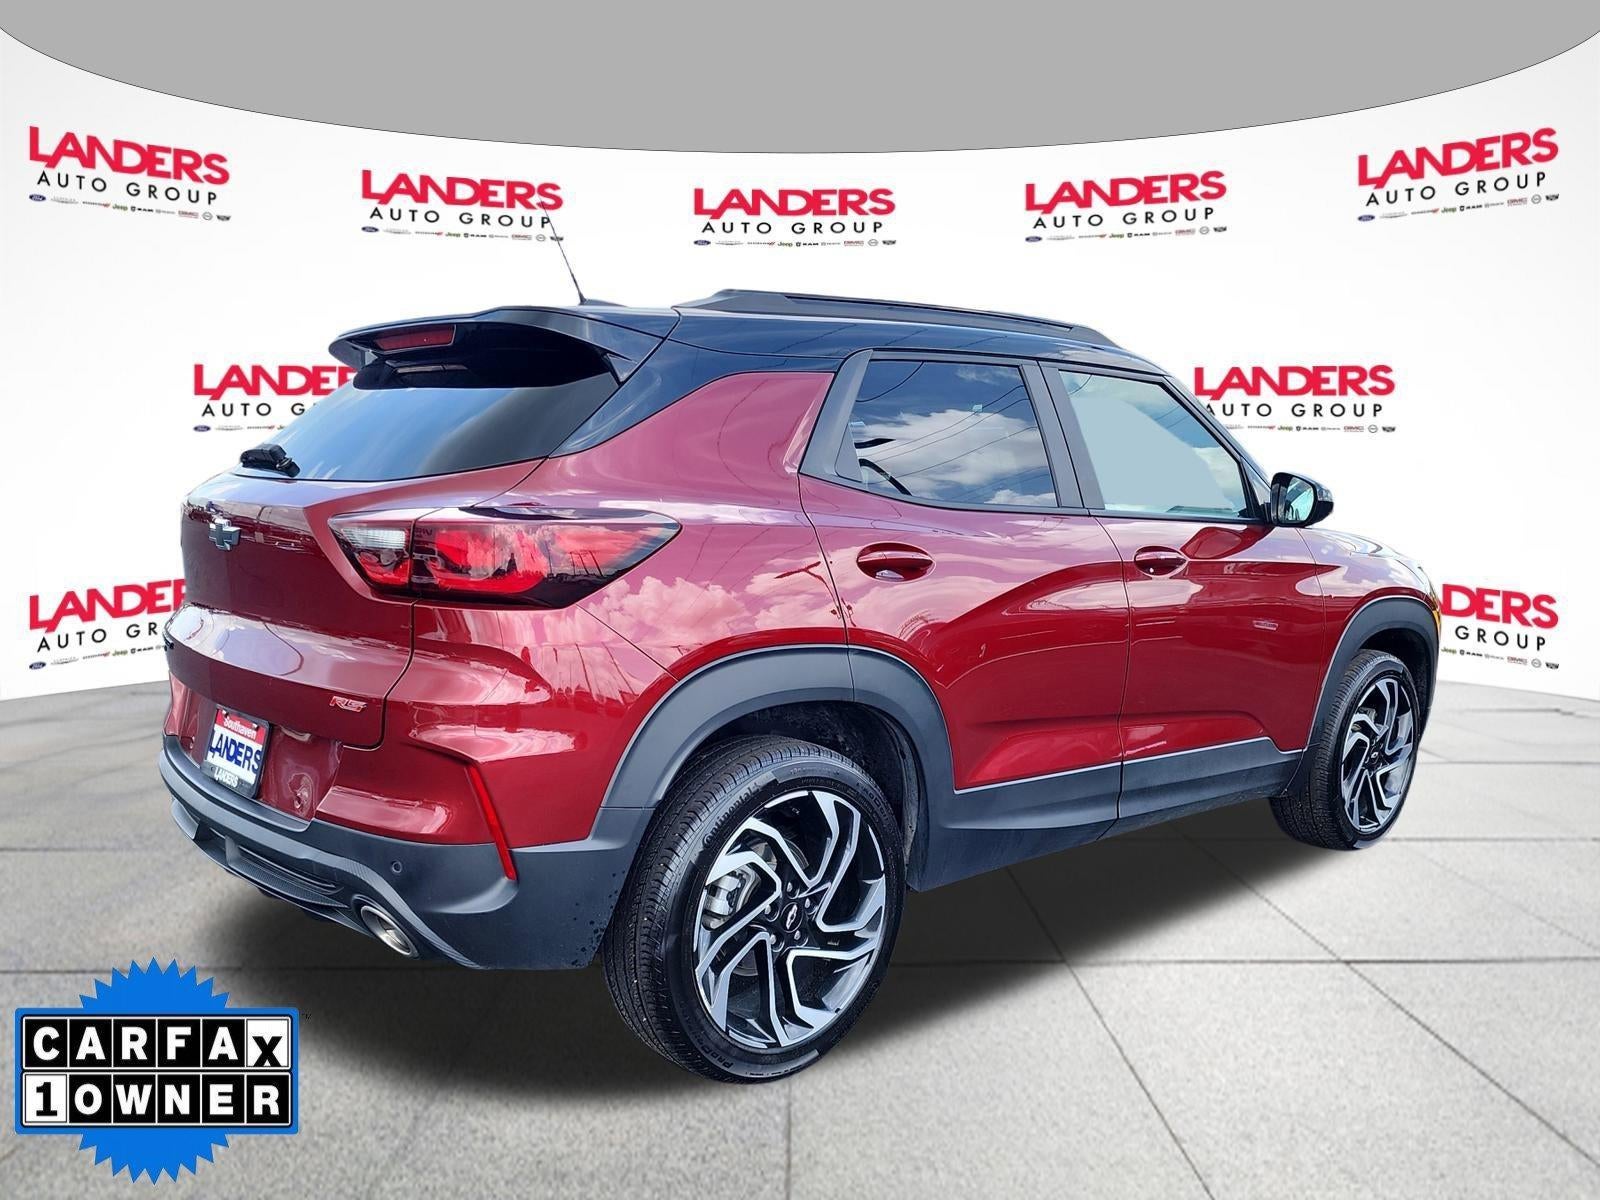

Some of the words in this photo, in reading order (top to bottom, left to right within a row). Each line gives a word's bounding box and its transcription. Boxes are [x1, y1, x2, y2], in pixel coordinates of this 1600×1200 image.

[30, 126, 230, 185] LANDERS
[1358, 127, 1559, 189] LANDERS
[37, 170, 107, 192] AUTO
[126, 182, 217, 205] GROUP
[362, 170, 563, 211] LANDERS
[1025, 171, 1227, 215] LANDERS
[1366, 185, 1436, 207] AUTO
[1455, 172, 1546, 196] GROUP
[369, 207, 440, 223] AUTO
[459, 212, 551, 228] GROUP
[694, 188, 896, 219] LANDERS
[1033, 214, 1104, 229] AUTO
[1122, 207, 1214, 225] GROUP
[701, 221, 772, 234] AUTO
[791, 222, 883, 234] GROUP
[194, 364, 357, 400] LANDE
[1194, 364, 1396, 401] LANDERS
[201, 403, 272, 417] AUTO
[1291, 403, 1383, 417] GROUP
[1440, 584, 1559, 629] DERS
[37, 628, 107, 653] AUTO
[1455, 625, 1546, 651] GROUP
[329, 695, 367, 713] RS
[223, 715, 257, 740] Southaven
